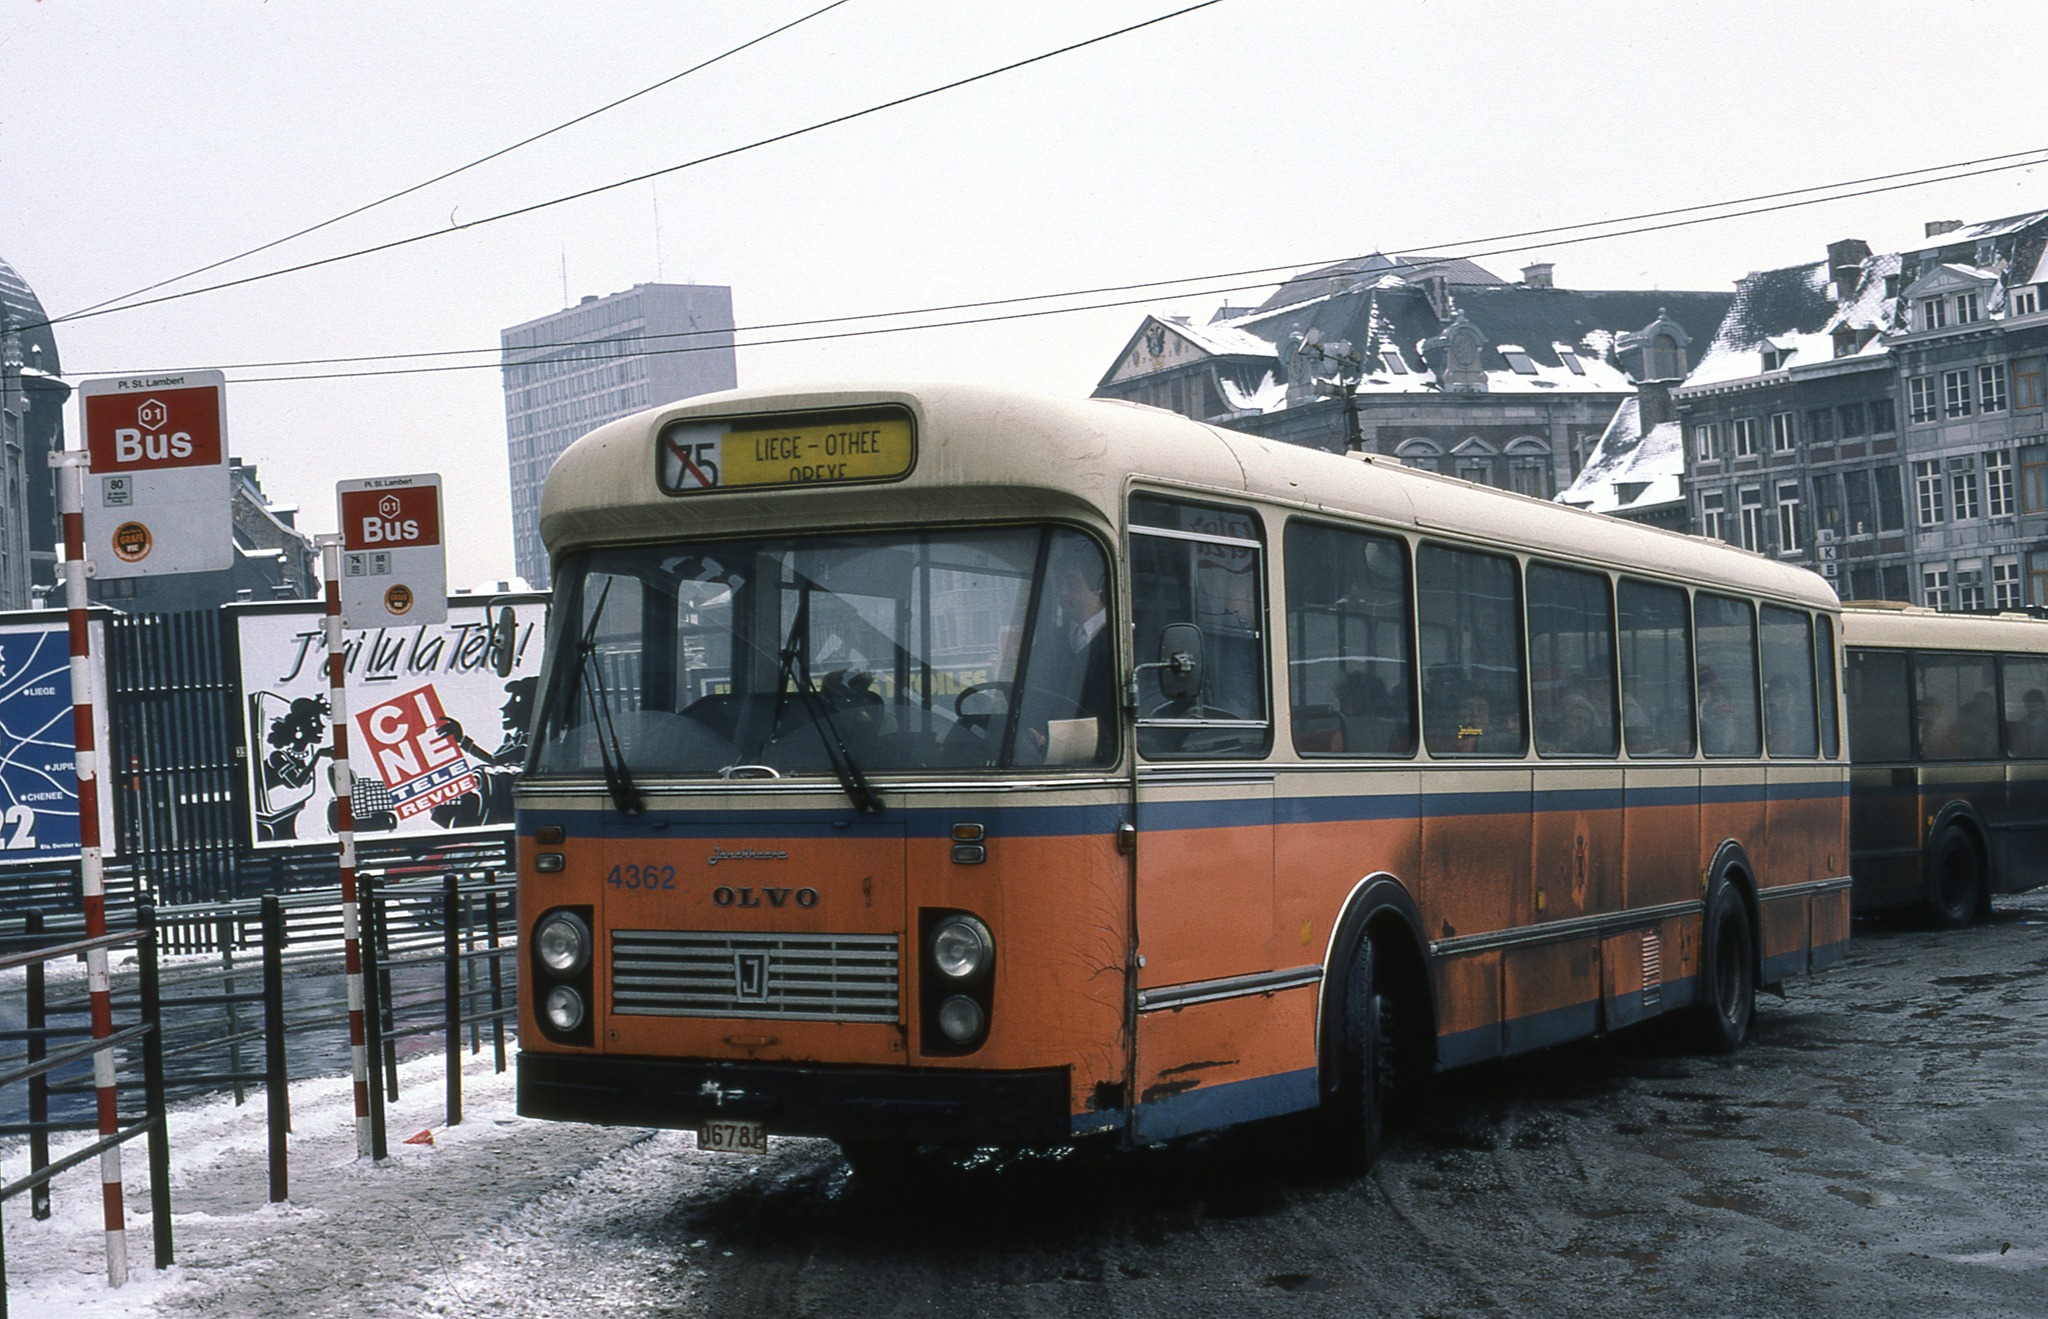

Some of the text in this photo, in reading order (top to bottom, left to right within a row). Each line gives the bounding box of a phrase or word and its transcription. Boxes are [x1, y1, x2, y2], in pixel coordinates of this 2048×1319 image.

[118, 376, 185, 390] Pl. St. Lambert
[142, 408, 162, 421] 01
[115, 428, 193, 463] Bus
[756, 437, 802, 462] LIEGE
[825, 430, 881, 456] OTHEE
[674, 442, 718, 489] 75
[110, 479, 124, 490] 80
[375, 479, 384, 487] St.
[385, 478, 413, 487] Lambert
[383, 501, 397, 512] 01
[363, 517, 419, 543] Bus
[367, 627, 406, 674] lu
[407, 625, 446, 672] la
[30, 687, 55, 696] LIEGE
[27, 792, 63, 801] CHENEE
[400, 777, 474, 818] REVUE
[607, 864, 676, 890] 4362
[712, 886, 819, 908] OLVO
